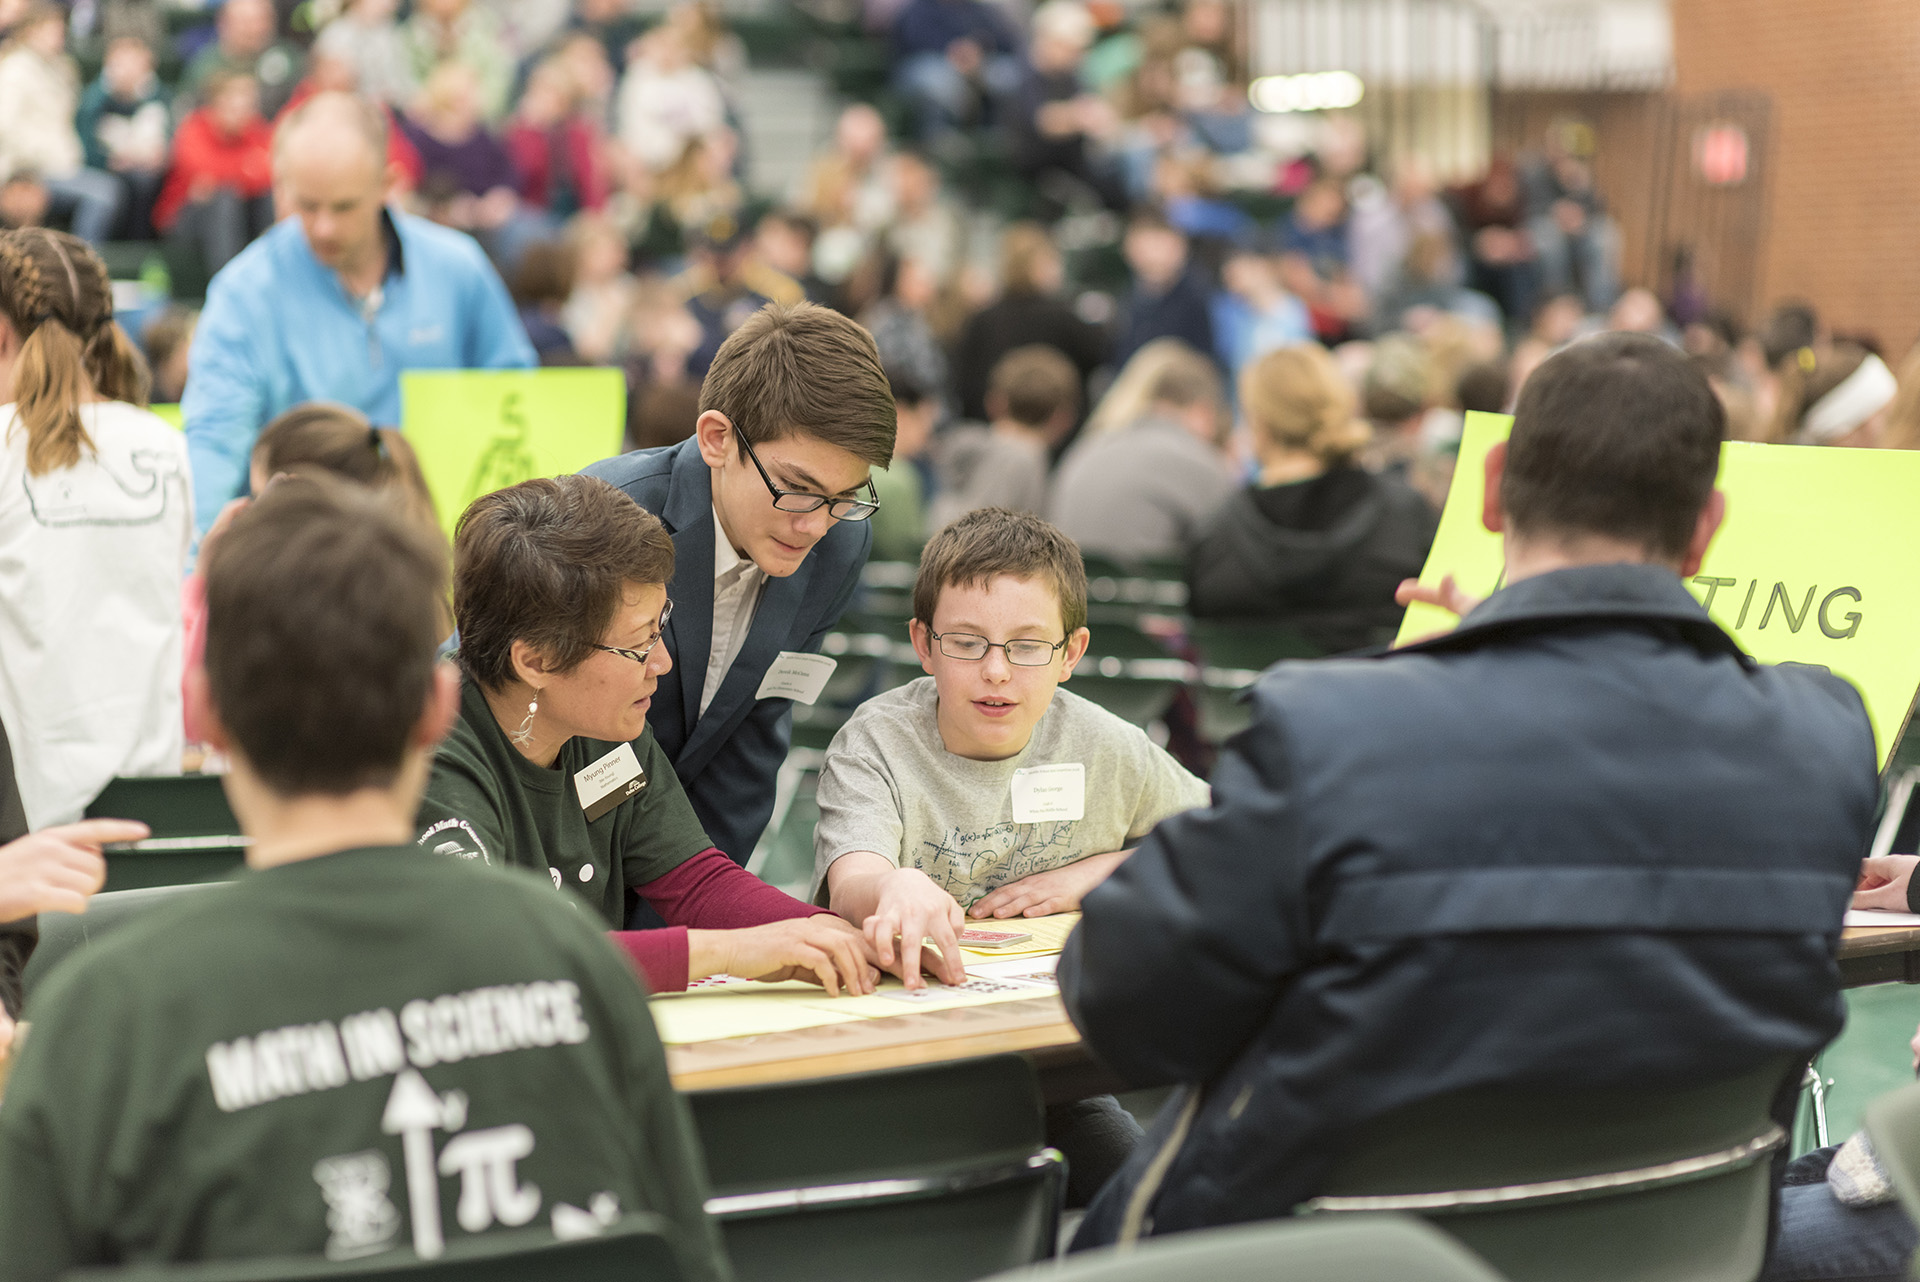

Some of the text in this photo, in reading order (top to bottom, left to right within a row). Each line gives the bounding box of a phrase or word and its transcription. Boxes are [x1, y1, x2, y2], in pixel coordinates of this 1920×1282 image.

[1692, 575, 1863, 639] TING
[583, 767, 604, 783] Myung
[603, 756, 621, 770] Pinner
[434, 817, 459, 833] Math
[206, 980, 590, 1112] MATH IN SCIENCE
